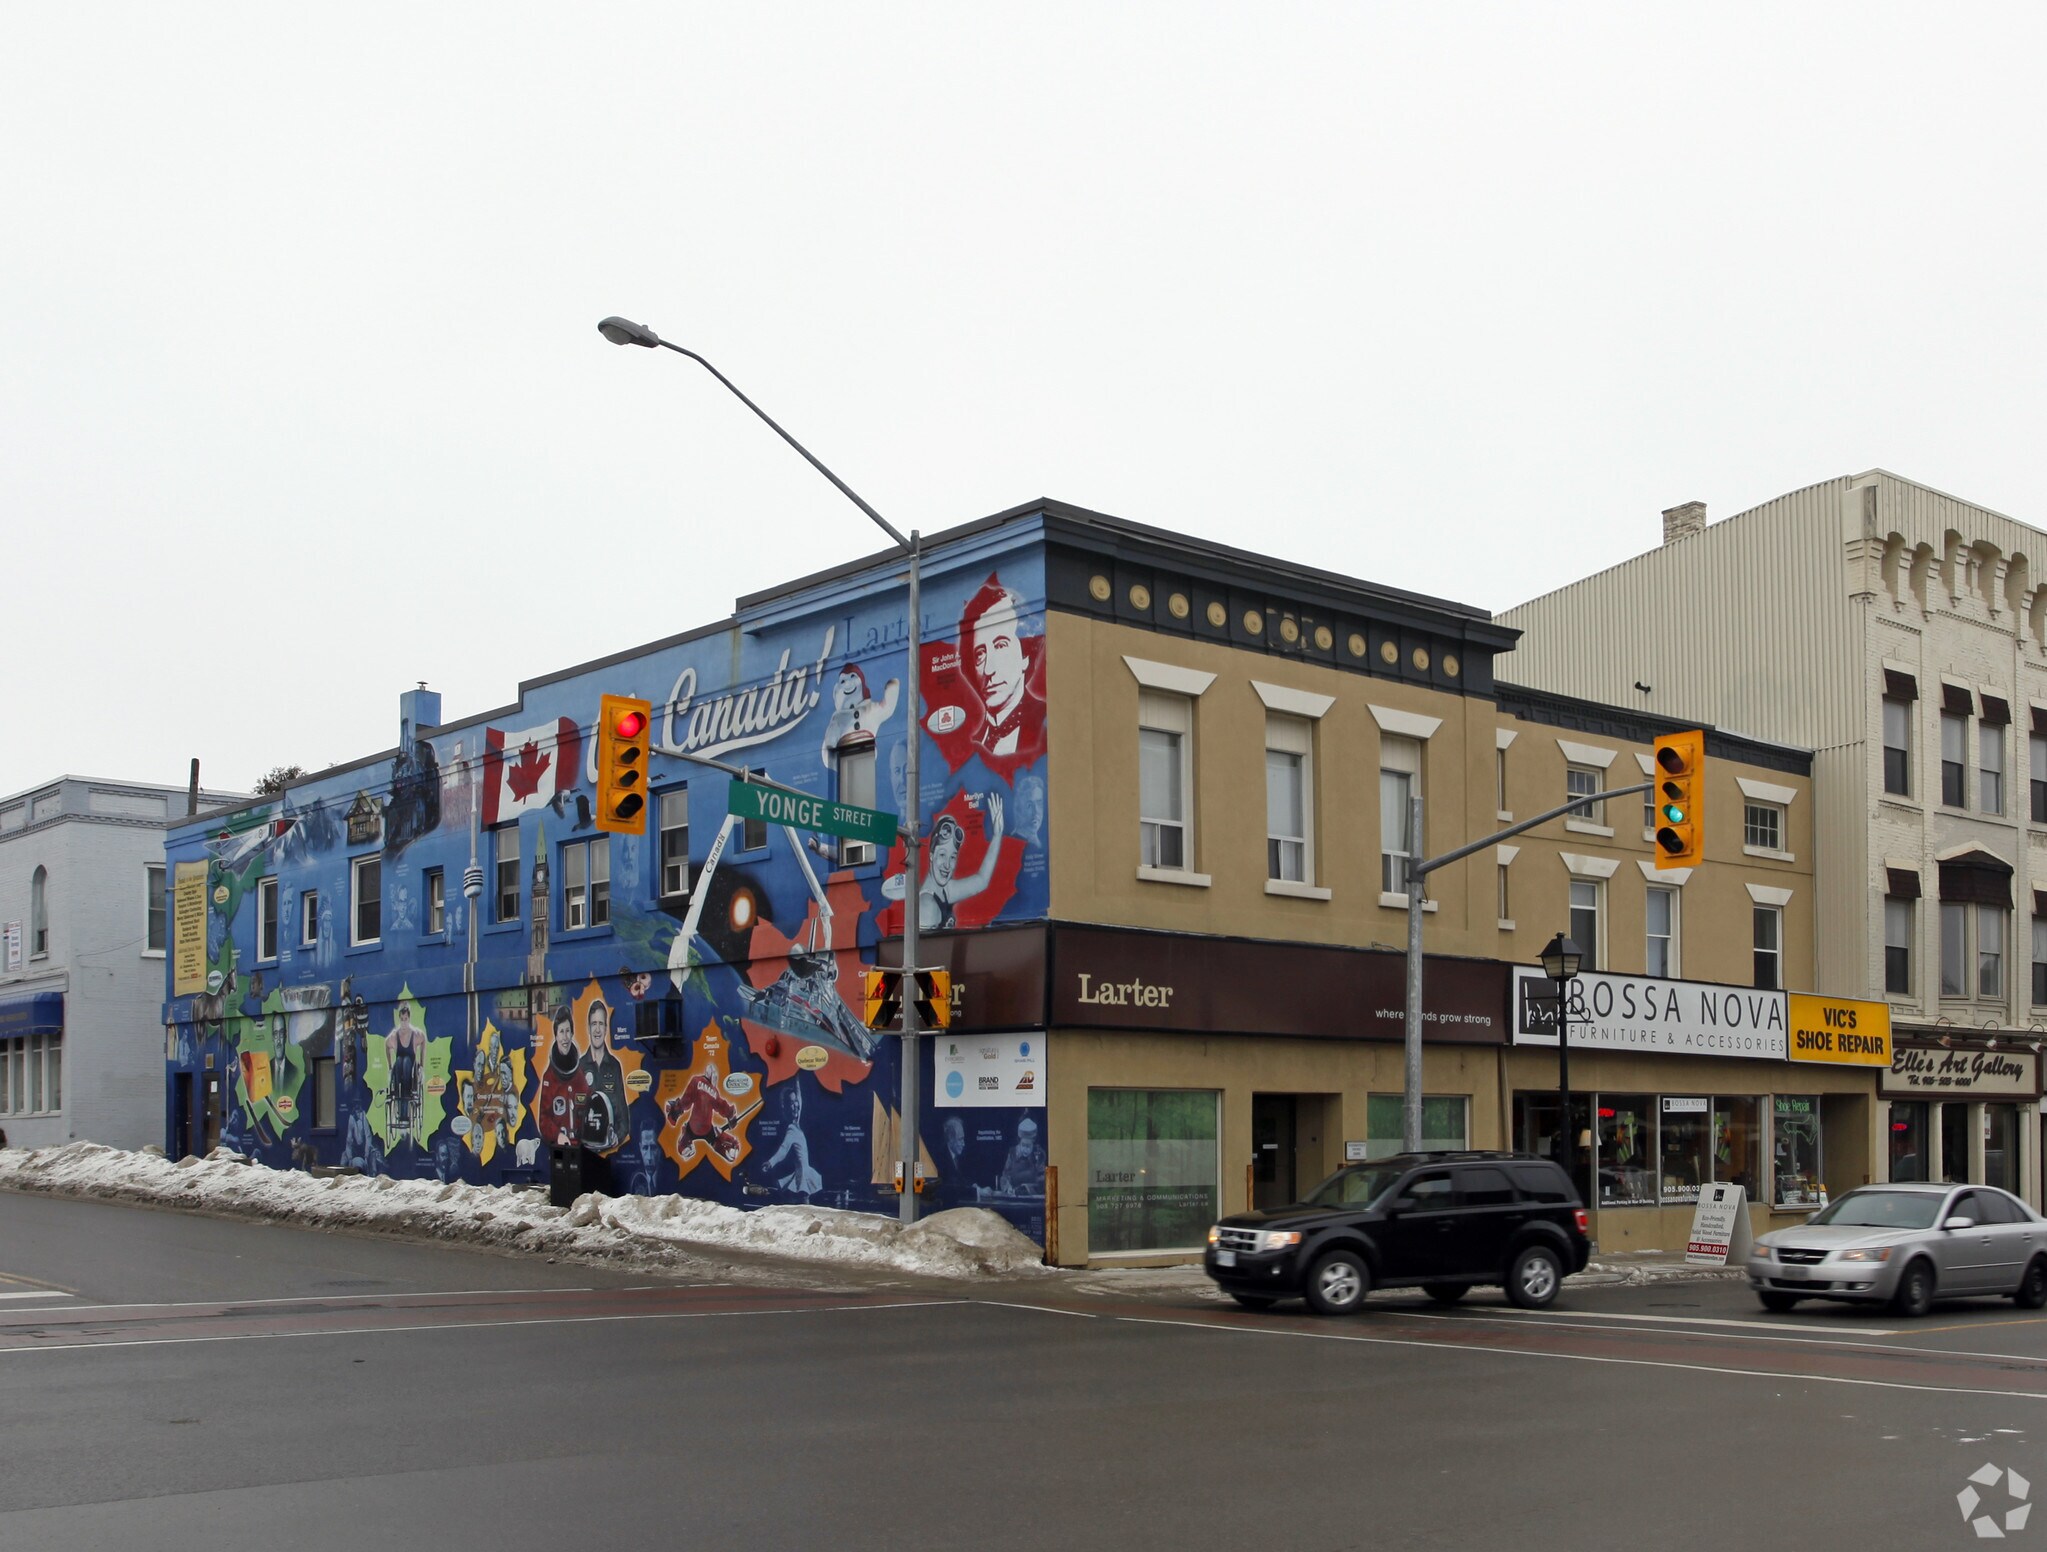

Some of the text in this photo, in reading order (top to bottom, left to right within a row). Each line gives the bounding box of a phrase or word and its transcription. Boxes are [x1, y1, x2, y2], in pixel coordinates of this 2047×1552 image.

[932, 656, 940, 664] Sir
[941, 653, 954, 662] John
[662, 625, 835, 759] Canada!
[756, 790, 873, 827] YONGE STREET
[706, 833, 725, 873] Canada
[1078, 973, 1174, 1007] Larter
[1571, 978, 1783, 1031] BOSSA NOVA
[1375, 1008, 1491, 1026] where nds grow strong
[1823, 1007, 1857, 1028] VIC'S
[1570, 1025, 1784, 1052] FURNITURE & ACCESSORIES
[1797, 1029, 1884, 1055] SHOE REPAIR
[1891, 1048, 2024, 1082] Elle's Art Gallery
[978, 1076, 999, 1084] BRAND
[697, 1081, 718, 1100] CANADA
[1671, 1099, 1707, 1107] BOSSA NOVA
[1775, 1098, 1810, 1113] Shoe Repair
[1096, 1170, 1135, 1183] Larter
[1146, 1193, 1208, 1201] COMMUNICATIONS
[1663, 1185, 1700, 1193] 905.900.03
[1688, 1244, 1727, 1253] 905.900.0310
